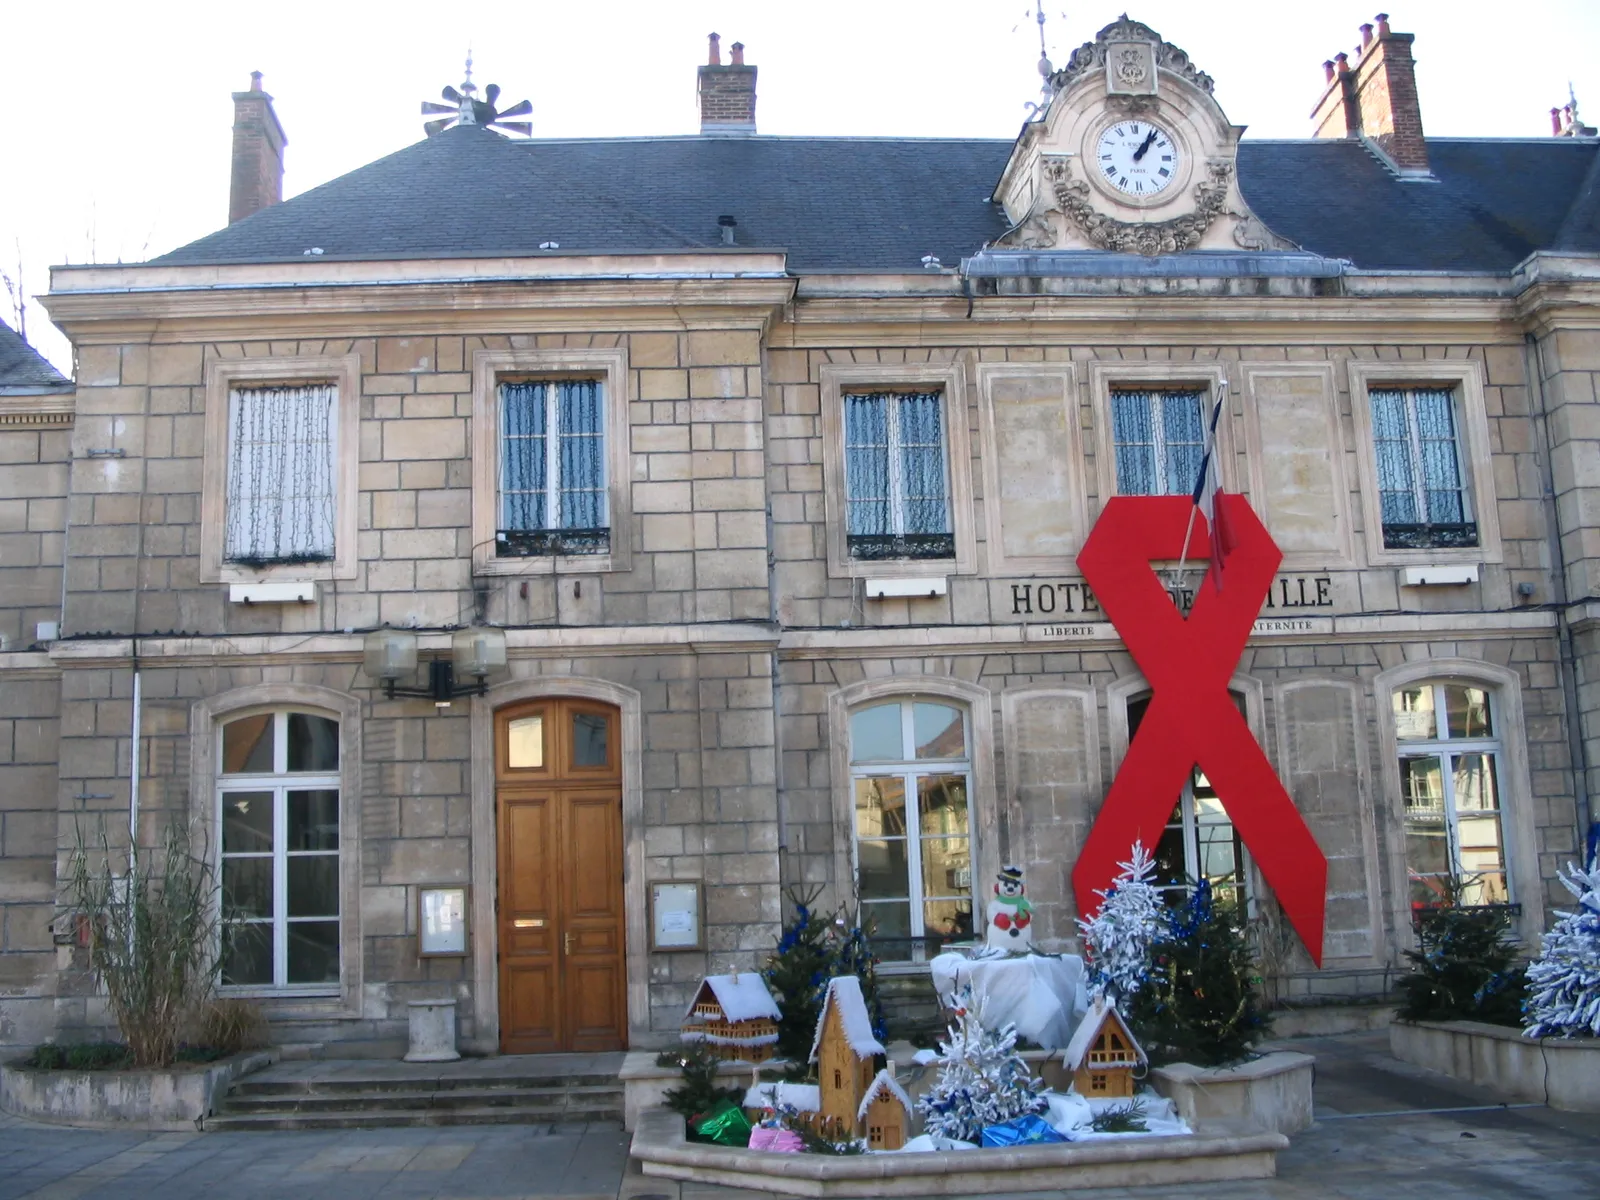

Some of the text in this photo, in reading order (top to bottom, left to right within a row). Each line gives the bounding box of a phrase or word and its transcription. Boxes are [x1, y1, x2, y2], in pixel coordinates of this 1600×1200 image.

[1011, 584, 1099, 614] HOTE
[1266, 578, 1333, 608] ILLE
[1253, 620, 1312, 631] ATERNITE
